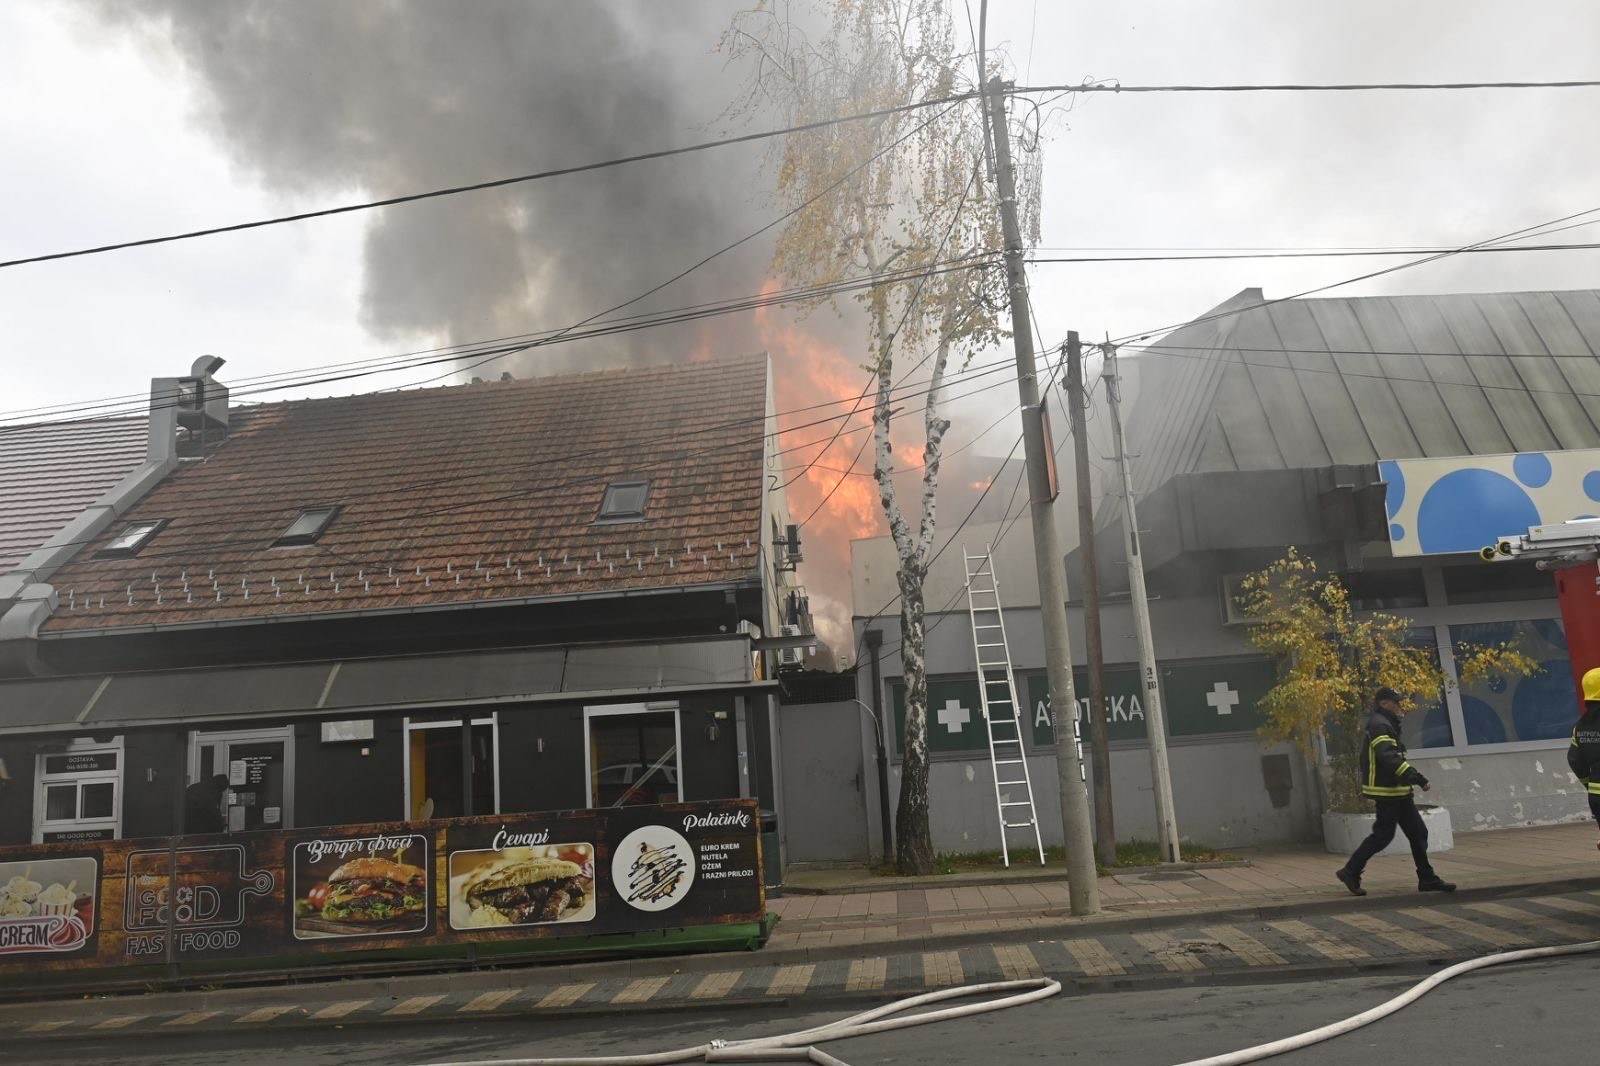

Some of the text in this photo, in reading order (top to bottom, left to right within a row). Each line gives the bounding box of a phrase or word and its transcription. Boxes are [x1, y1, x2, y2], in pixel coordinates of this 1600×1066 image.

[1035, 694, 1145, 728] ATKA
[683, 810, 751, 833] Palačinke
[307, 834, 413, 863] Burger obroci
[492, 824, 550, 852] Ćevapi
[701, 843, 740, 852] EURO KREM
[701, 853, 728, 861] NUTELA
[702, 862, 722, 870] DŽEM
[705, 871, 727, 879] RAZNI
[727, 869, 754, 878] PRILOZI
[126, 930, 241, 955] FAS FOOD
